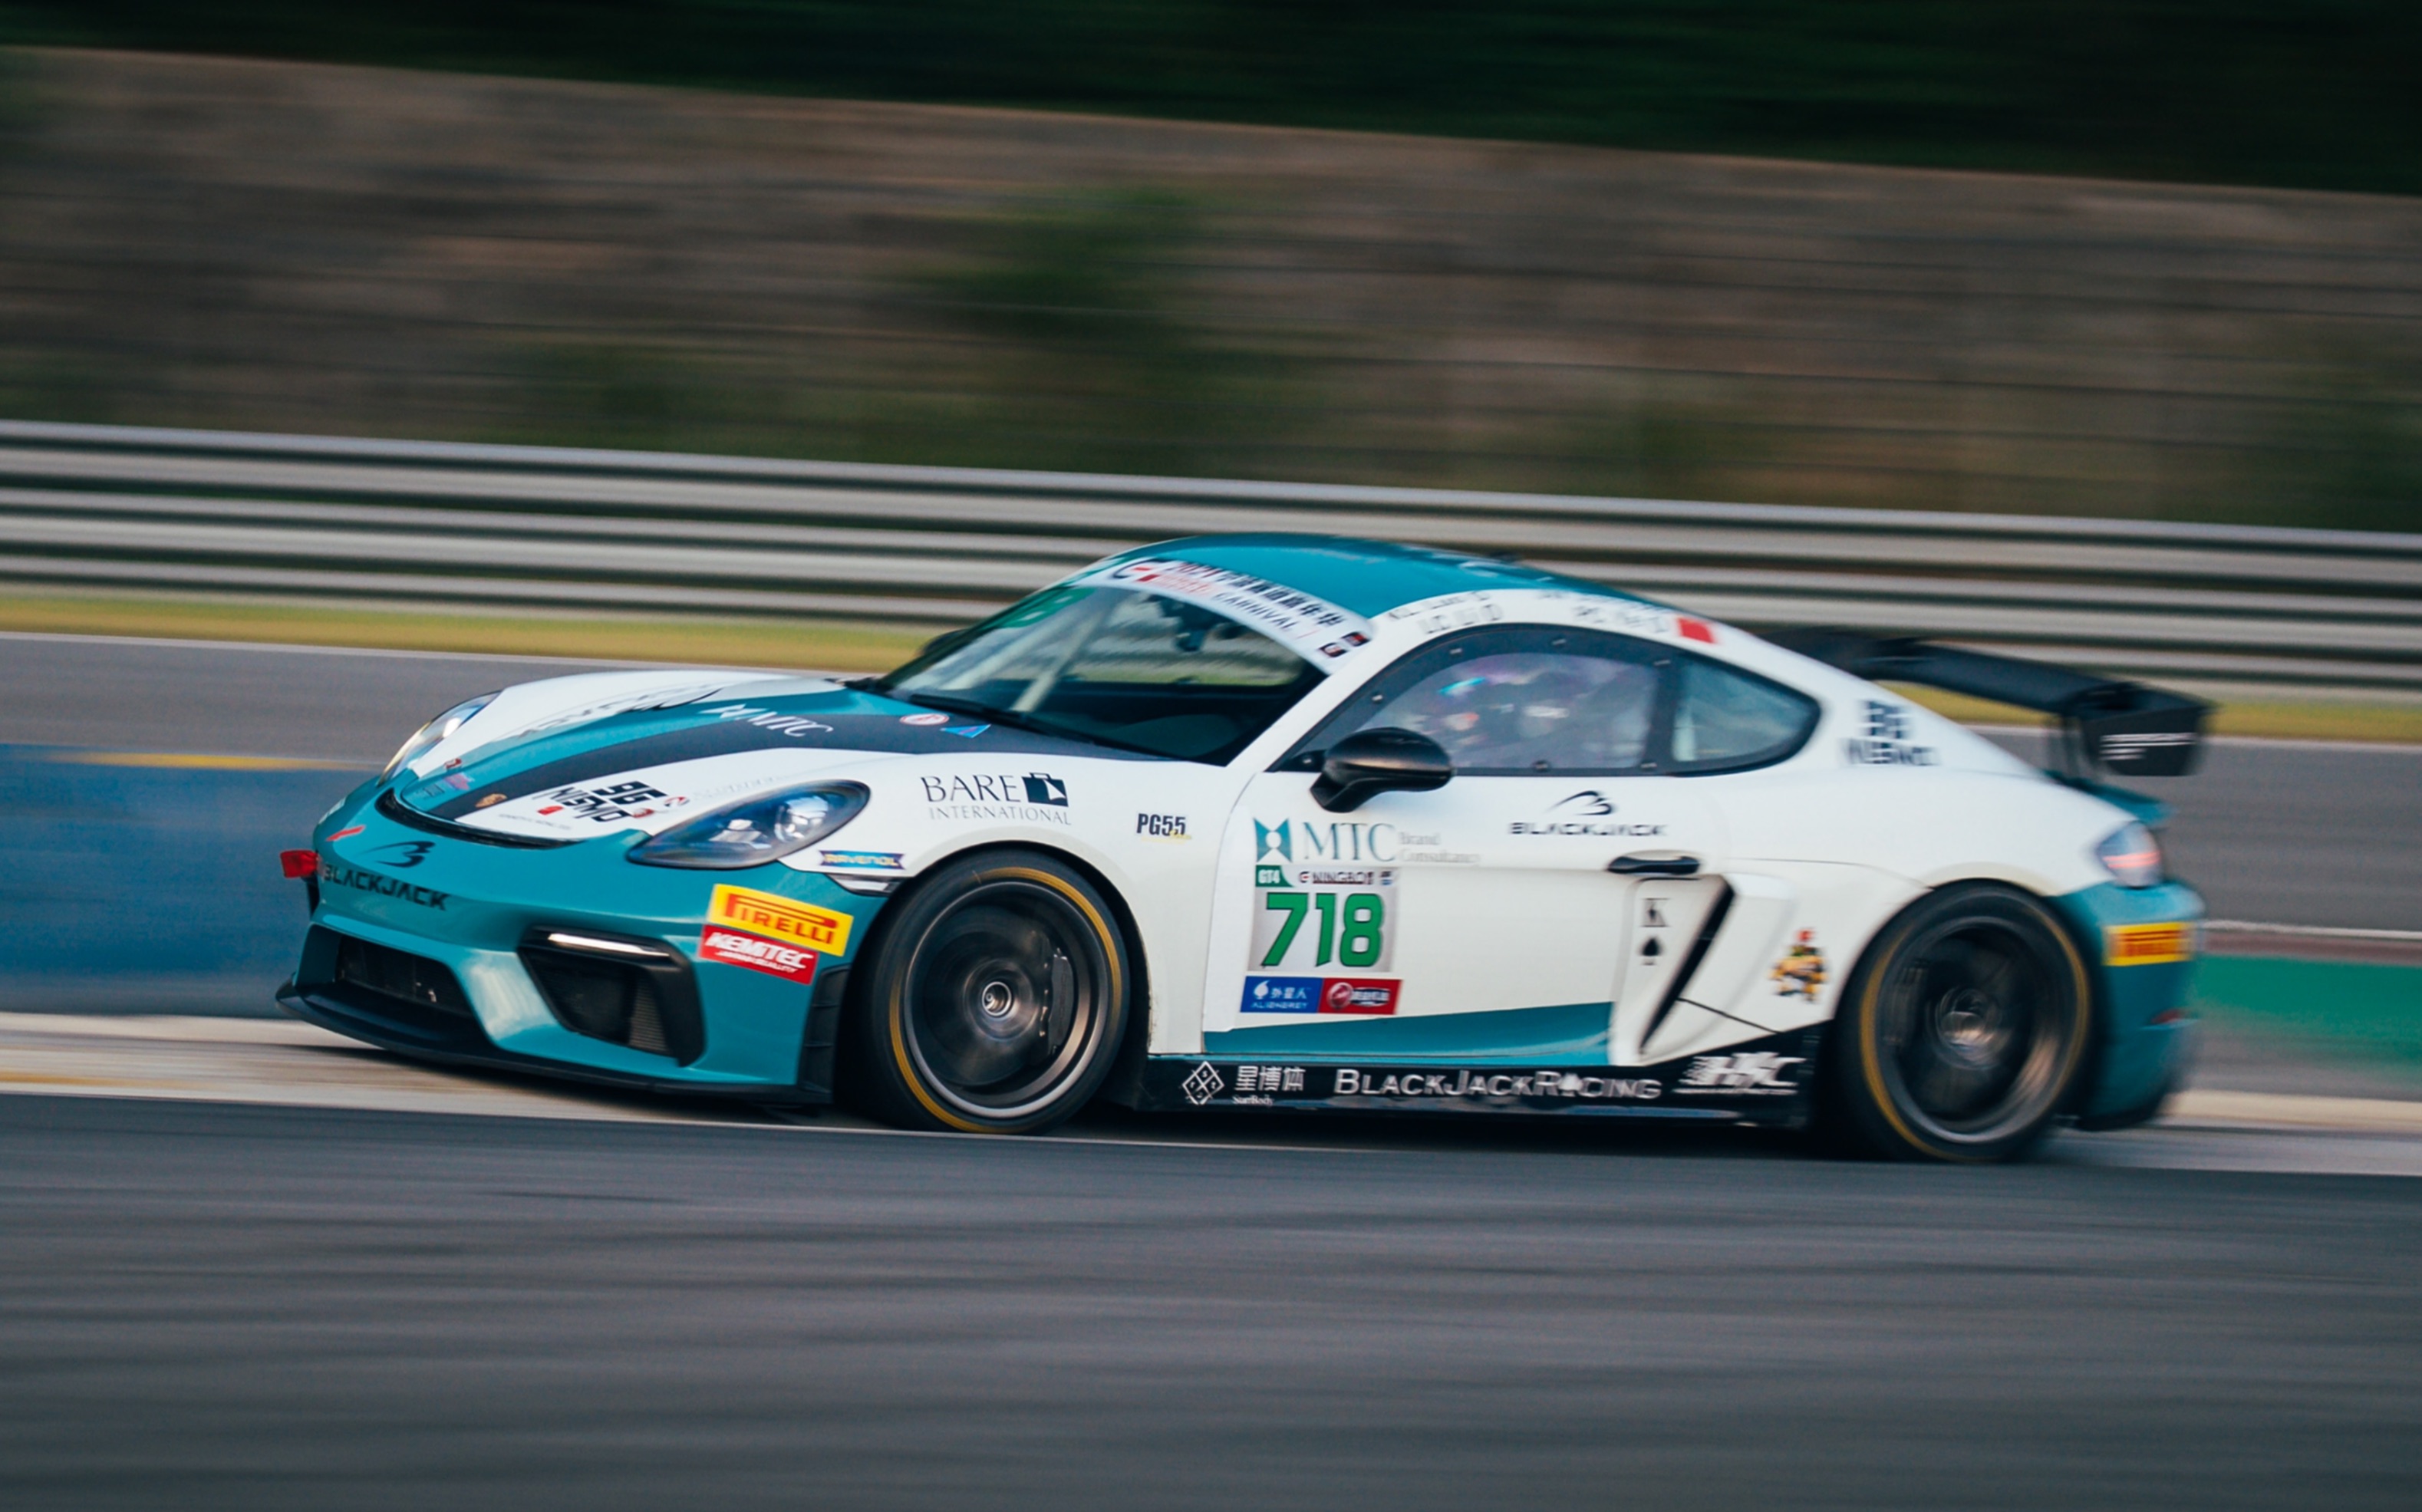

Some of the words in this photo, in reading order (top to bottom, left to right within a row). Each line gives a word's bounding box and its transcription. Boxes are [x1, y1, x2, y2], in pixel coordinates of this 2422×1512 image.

[532, 786, 634, 822] NISMO
[921, 774, 1022, 803] BARE
[928, 805, 1072, 826] INTERNATIONAL
[1136, 813, 1186, 837] PG55
[1509, 822, 1668, 836] BLACKJACK
[1302, 822, 1396, 862] MTC
[317, 865, 450, 911] BLACKJACK
[1257, 869, 1281, 884] GT4
[724, 893, 839, 945] PIRELLI
[1640, 898, 1670, 927] K
[1260, 891, 1385, 968] 718
[704, 931, 815, 970] KEMTEC
